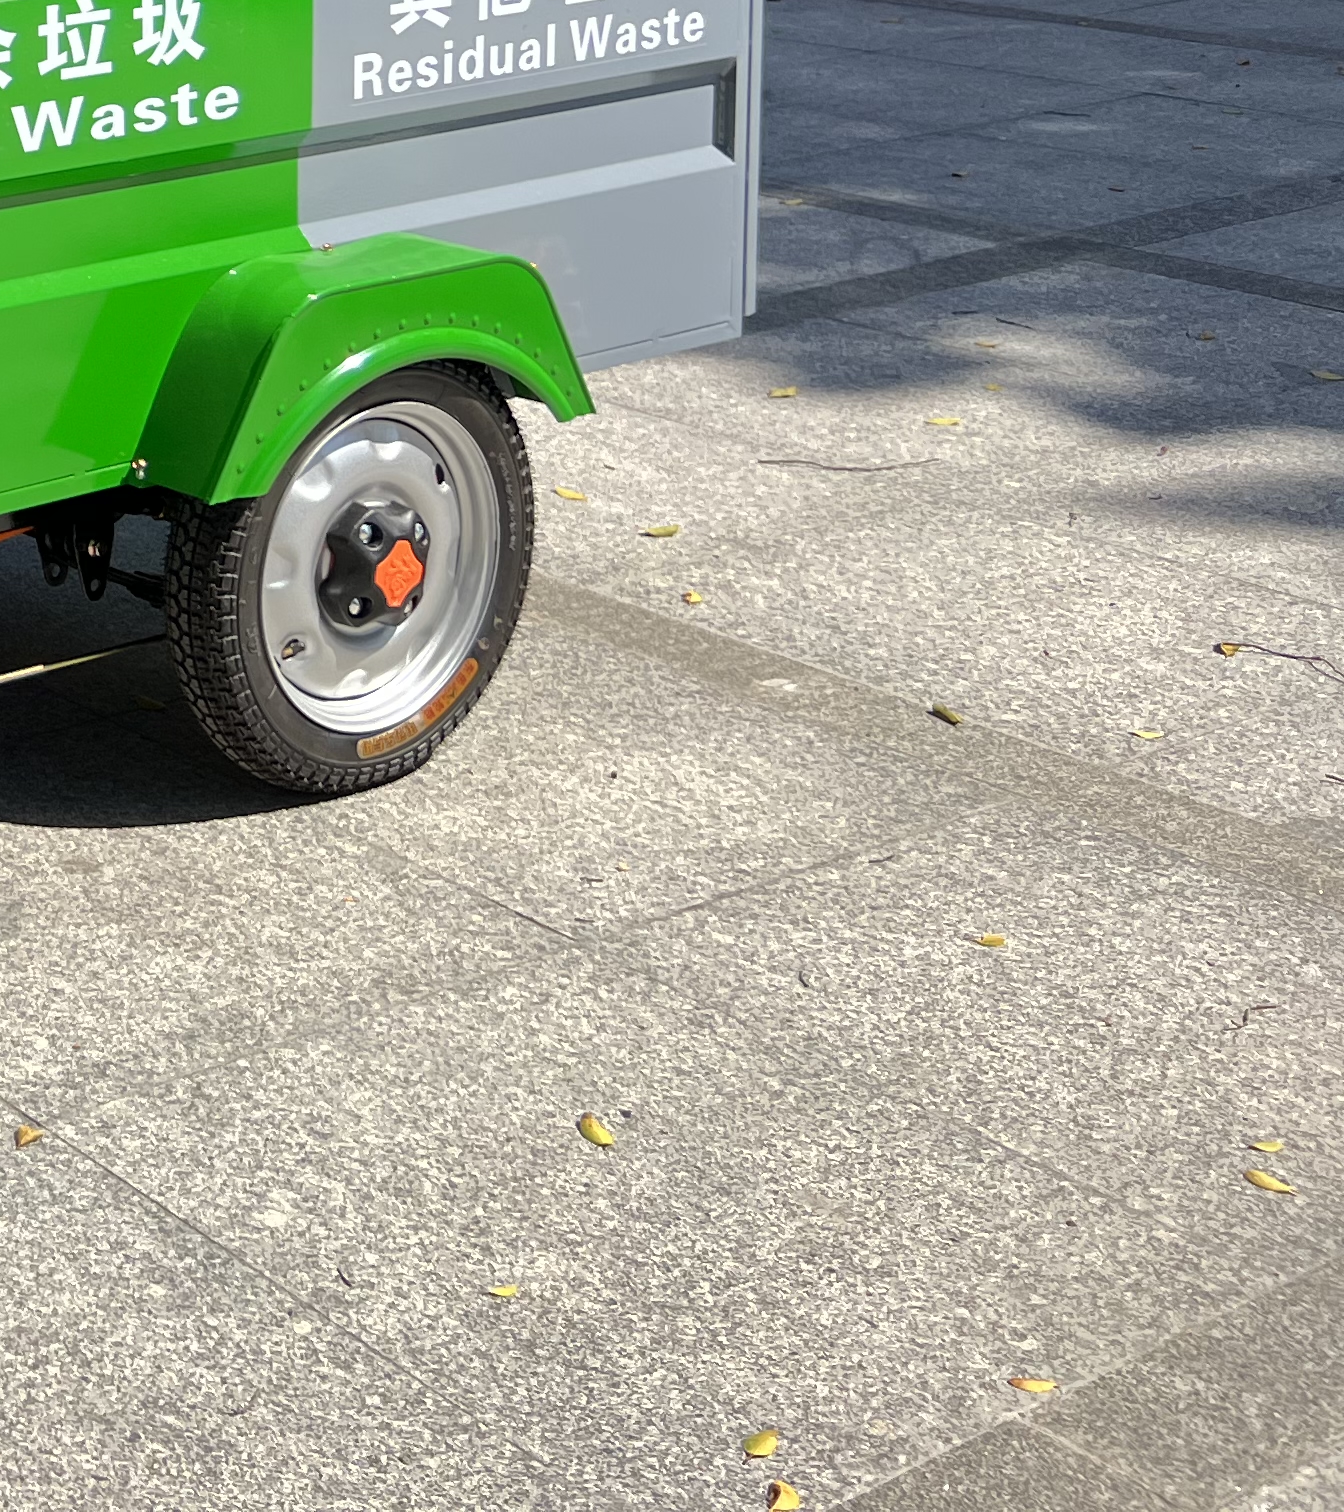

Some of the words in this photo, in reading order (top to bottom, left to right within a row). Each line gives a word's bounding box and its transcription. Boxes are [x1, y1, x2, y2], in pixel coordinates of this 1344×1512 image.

[353, 23, 557, 100] Residual
[569, 7, 706, 62] Waste
[11, 83, 240, 153] Waste
